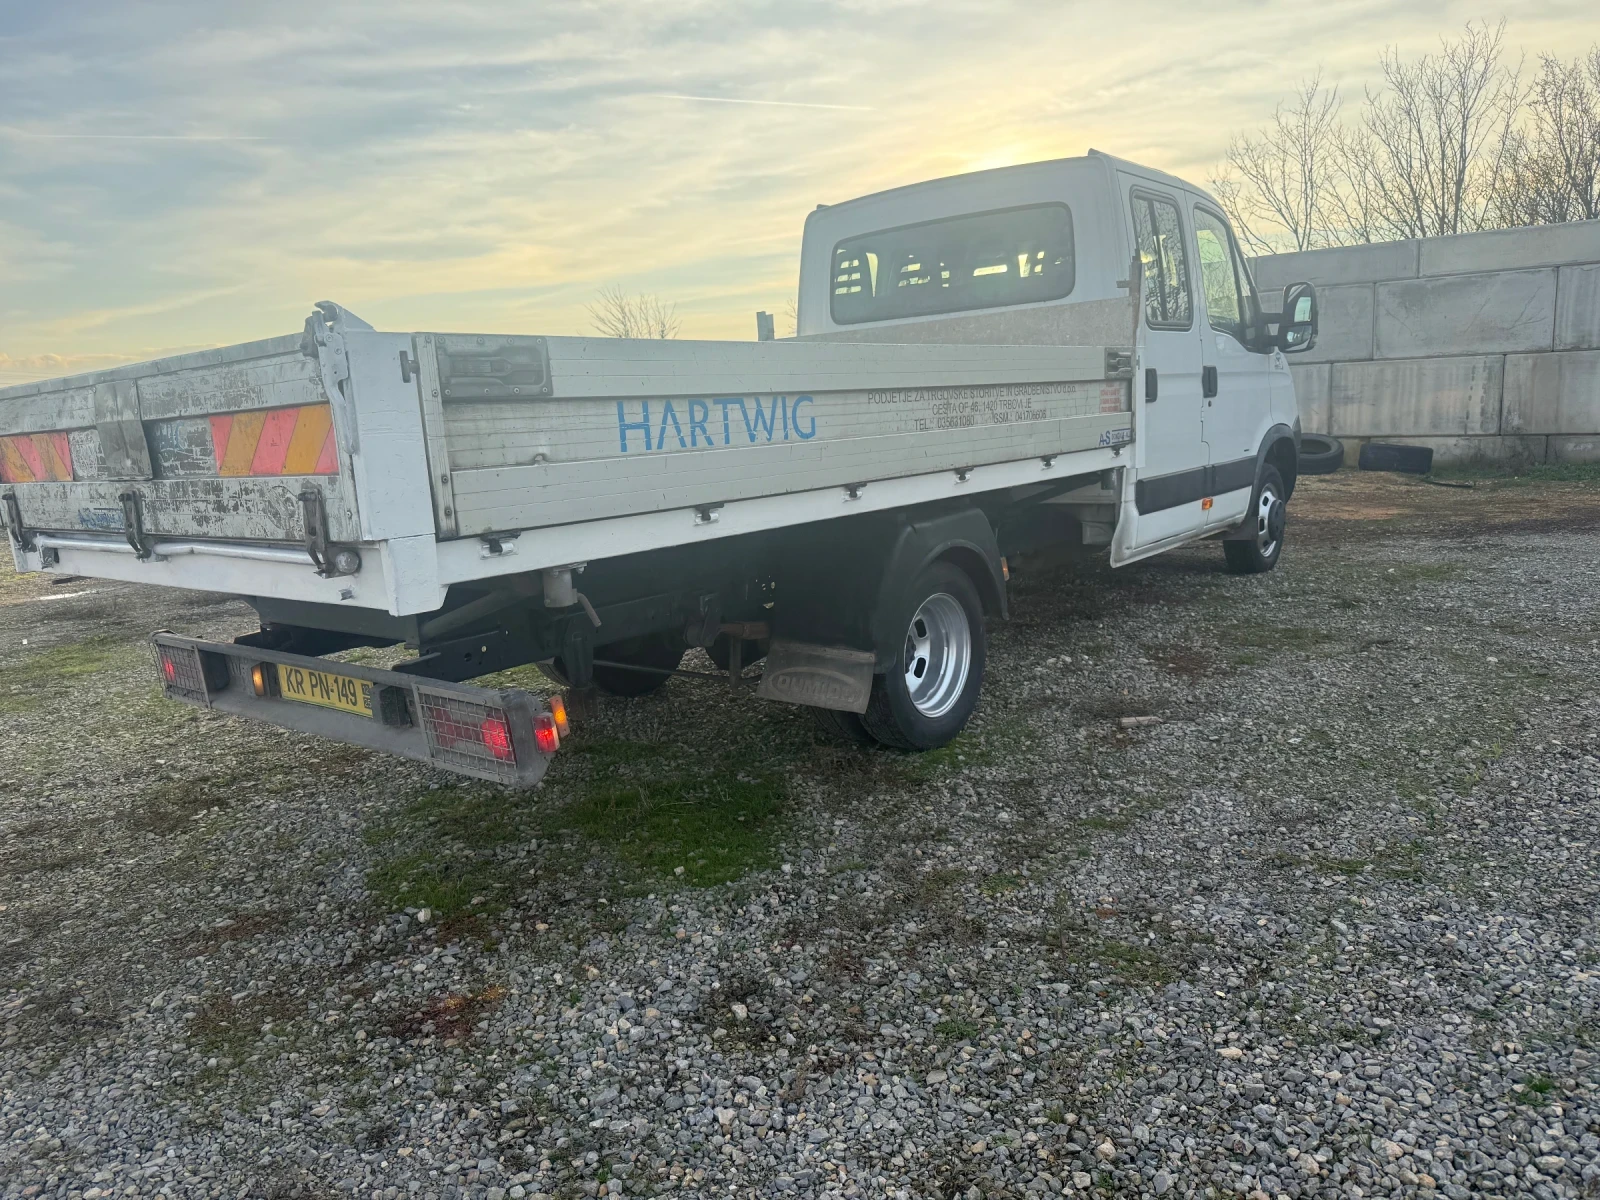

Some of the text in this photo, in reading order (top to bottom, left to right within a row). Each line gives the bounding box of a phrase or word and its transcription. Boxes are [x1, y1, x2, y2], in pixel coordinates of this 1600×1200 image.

[868, 392, 912, 404] PODJETJE
[914, 390, 925, 402] ZA
[927, 389, 968, 401] TRGOVSKE
[932, 402, 958, 416] CESTA
[616, 395, 816, 453] HARTWIG
[285, 667, 358, 707] KR PN-149
